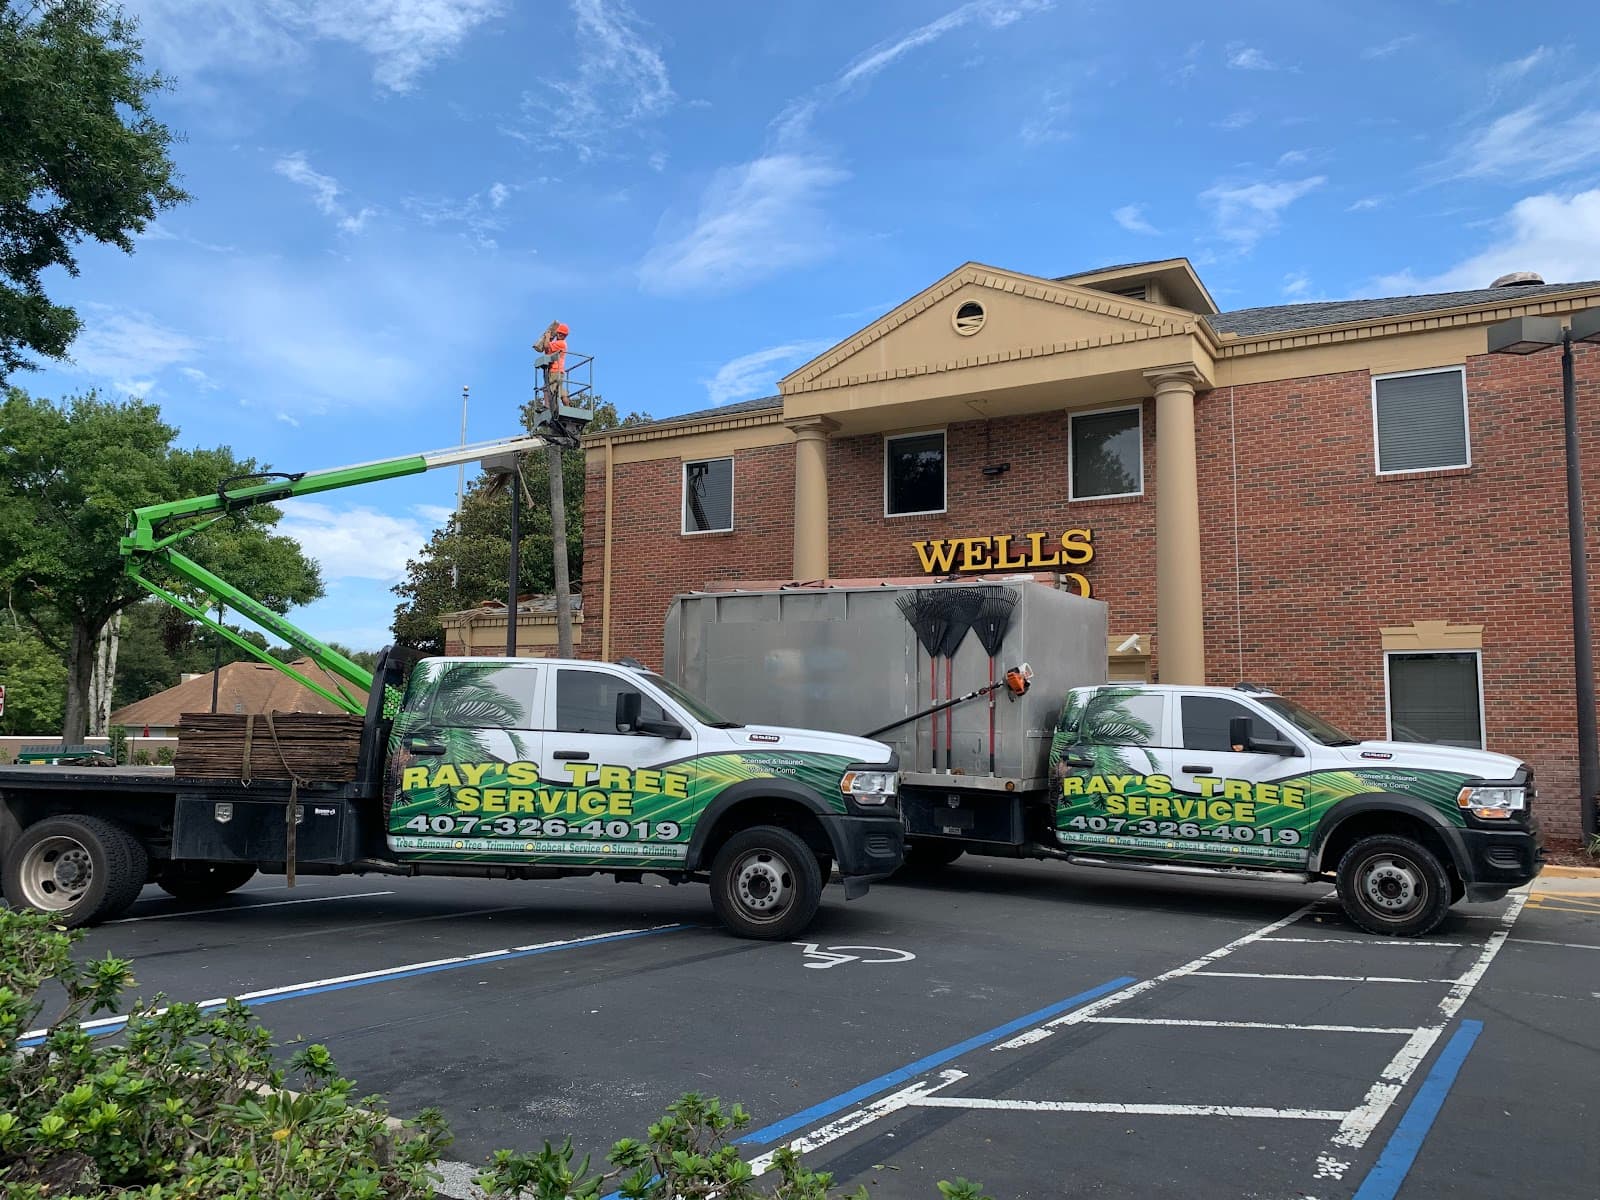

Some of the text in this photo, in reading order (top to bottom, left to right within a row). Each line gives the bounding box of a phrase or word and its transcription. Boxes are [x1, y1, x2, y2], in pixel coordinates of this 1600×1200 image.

[912, 528, 1094, 573] WELLS
[401, 761, 690, 799] RAY'S TREE
[776, 767, 797, 775] Comp
[454, 787, 634, 816] SERVICE
[1063, 774, 1306, 809] RAY'S TREE
[1105, 795, 1256, 823] SERVICE
[405, 814, 681, 841] 407-326-4019
[1069, 815, 1301, 846] 407-326-4019
[395, 837, 678, 857] Tree Removal Tree Trimming Bobcat Service Stump Grinding
